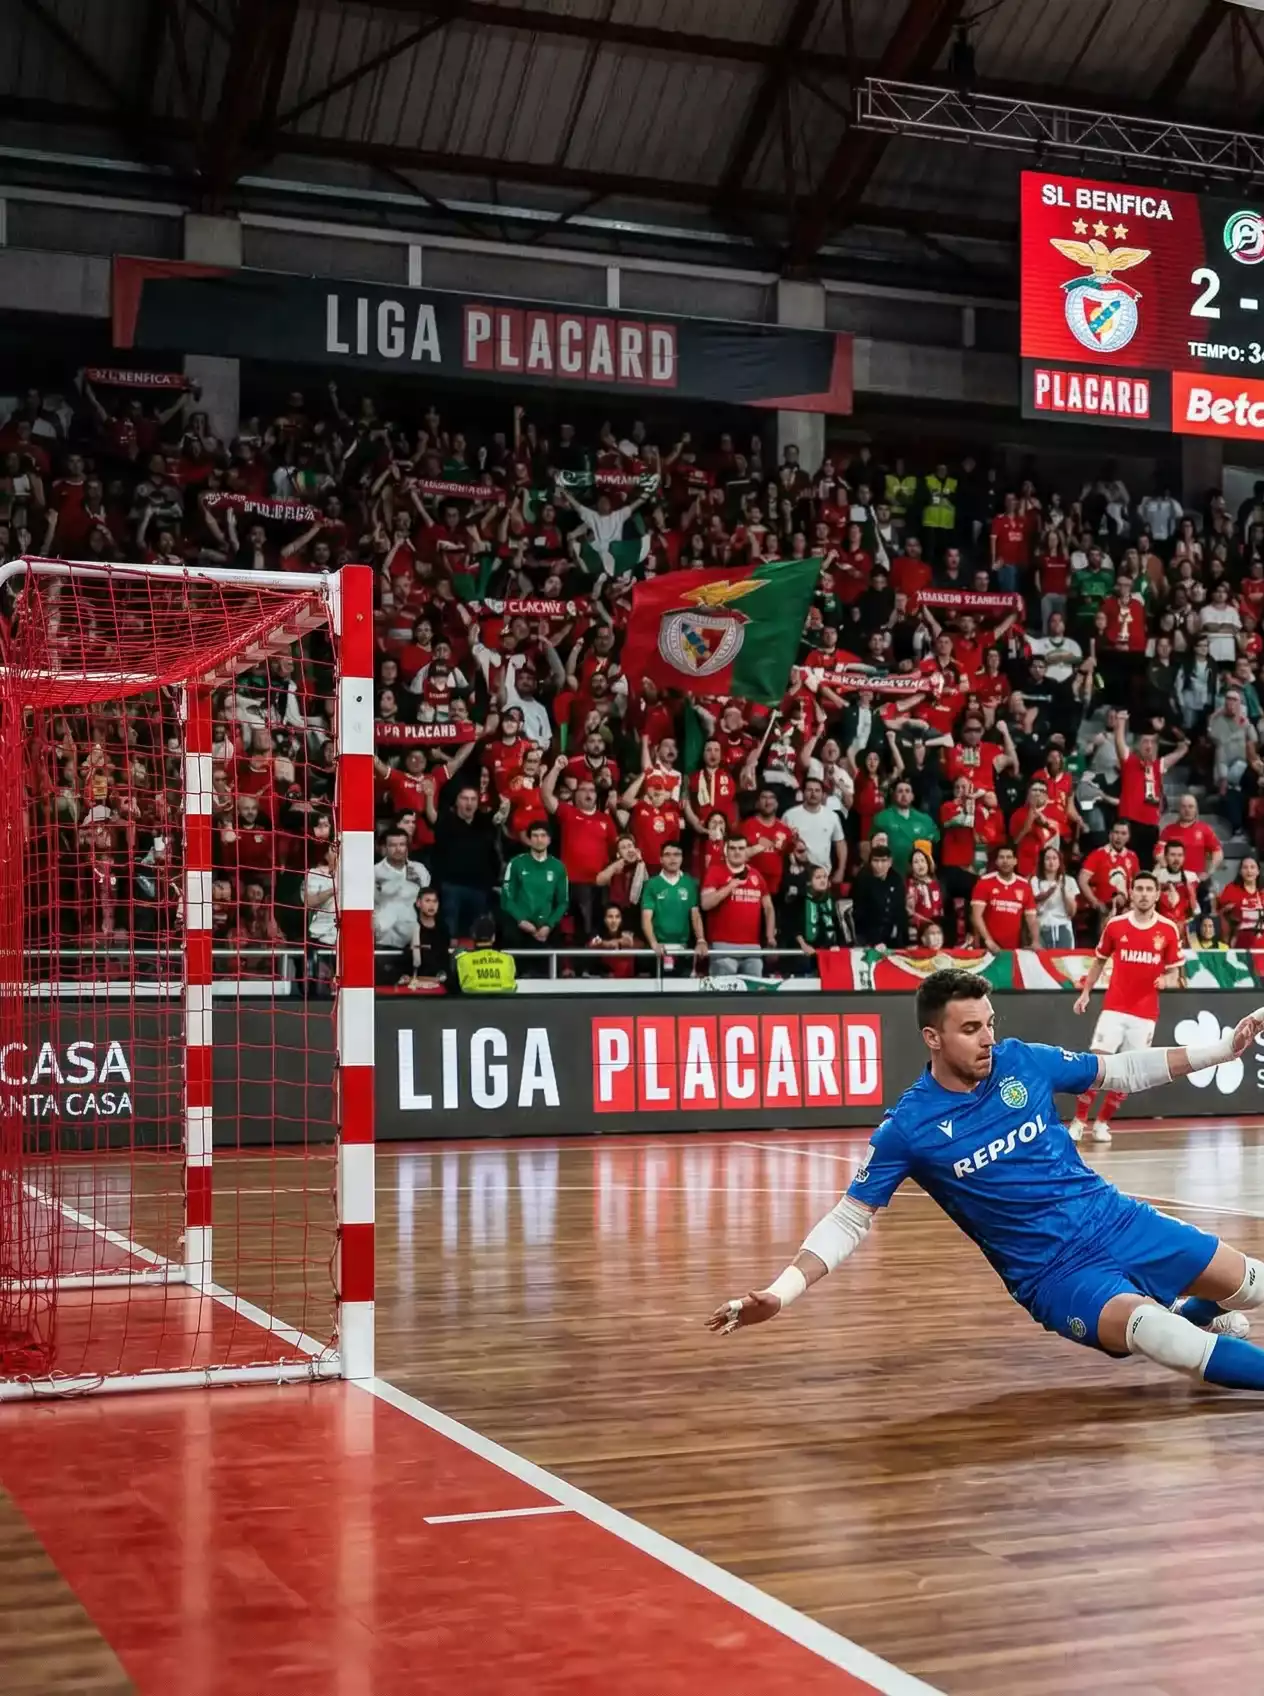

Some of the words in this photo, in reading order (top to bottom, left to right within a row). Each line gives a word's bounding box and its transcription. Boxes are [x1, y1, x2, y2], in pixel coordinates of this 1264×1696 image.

[1041, 183, 1071, 207] SL
[1076, 187, 1174, 222] BENFICA
[1190, 268, 1221, 318] 2
[326, 293, 441, 363] LIGA
[467, 309, 674, 381] PLACARD
[1187, 341, 1245, 362] TEMPO:
[1035, 372, 1149, 416] PLACARD
[0, 1041, 132, 1085] CASA
[398, 1027, 560, 1110] LIGA
[597, 1024, 880, 1102] PLACARD
[65, 1092, 133, 1116] CASA
[952, 1113, 1047, 1179] REPSOL
